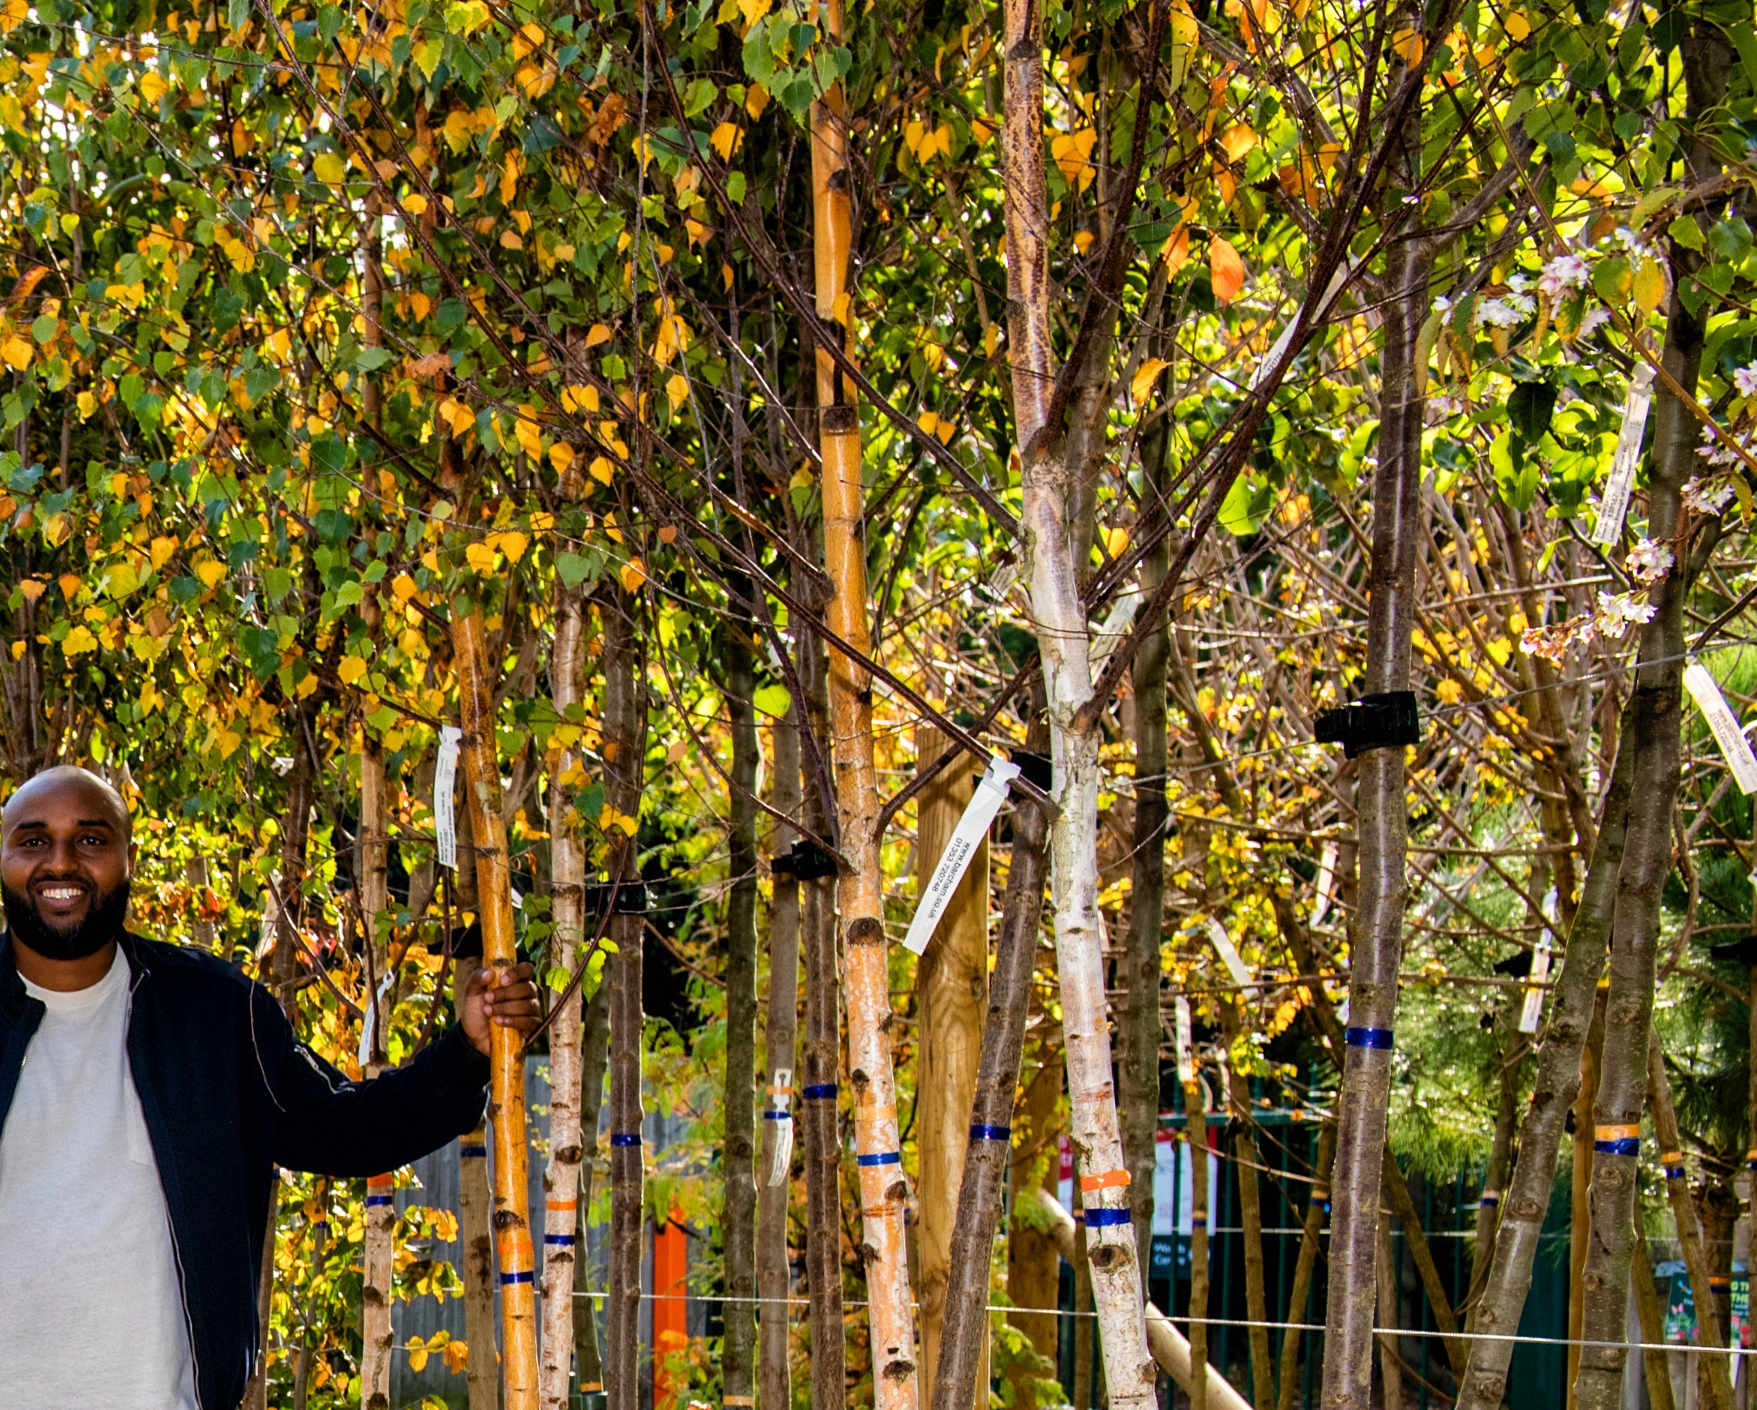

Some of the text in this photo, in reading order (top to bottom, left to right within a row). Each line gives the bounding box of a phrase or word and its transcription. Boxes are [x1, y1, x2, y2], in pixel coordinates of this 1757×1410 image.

[928, 842, 970, 919] www.barcham.co.uk
[932, 837, 962, 892] 01353 720748
